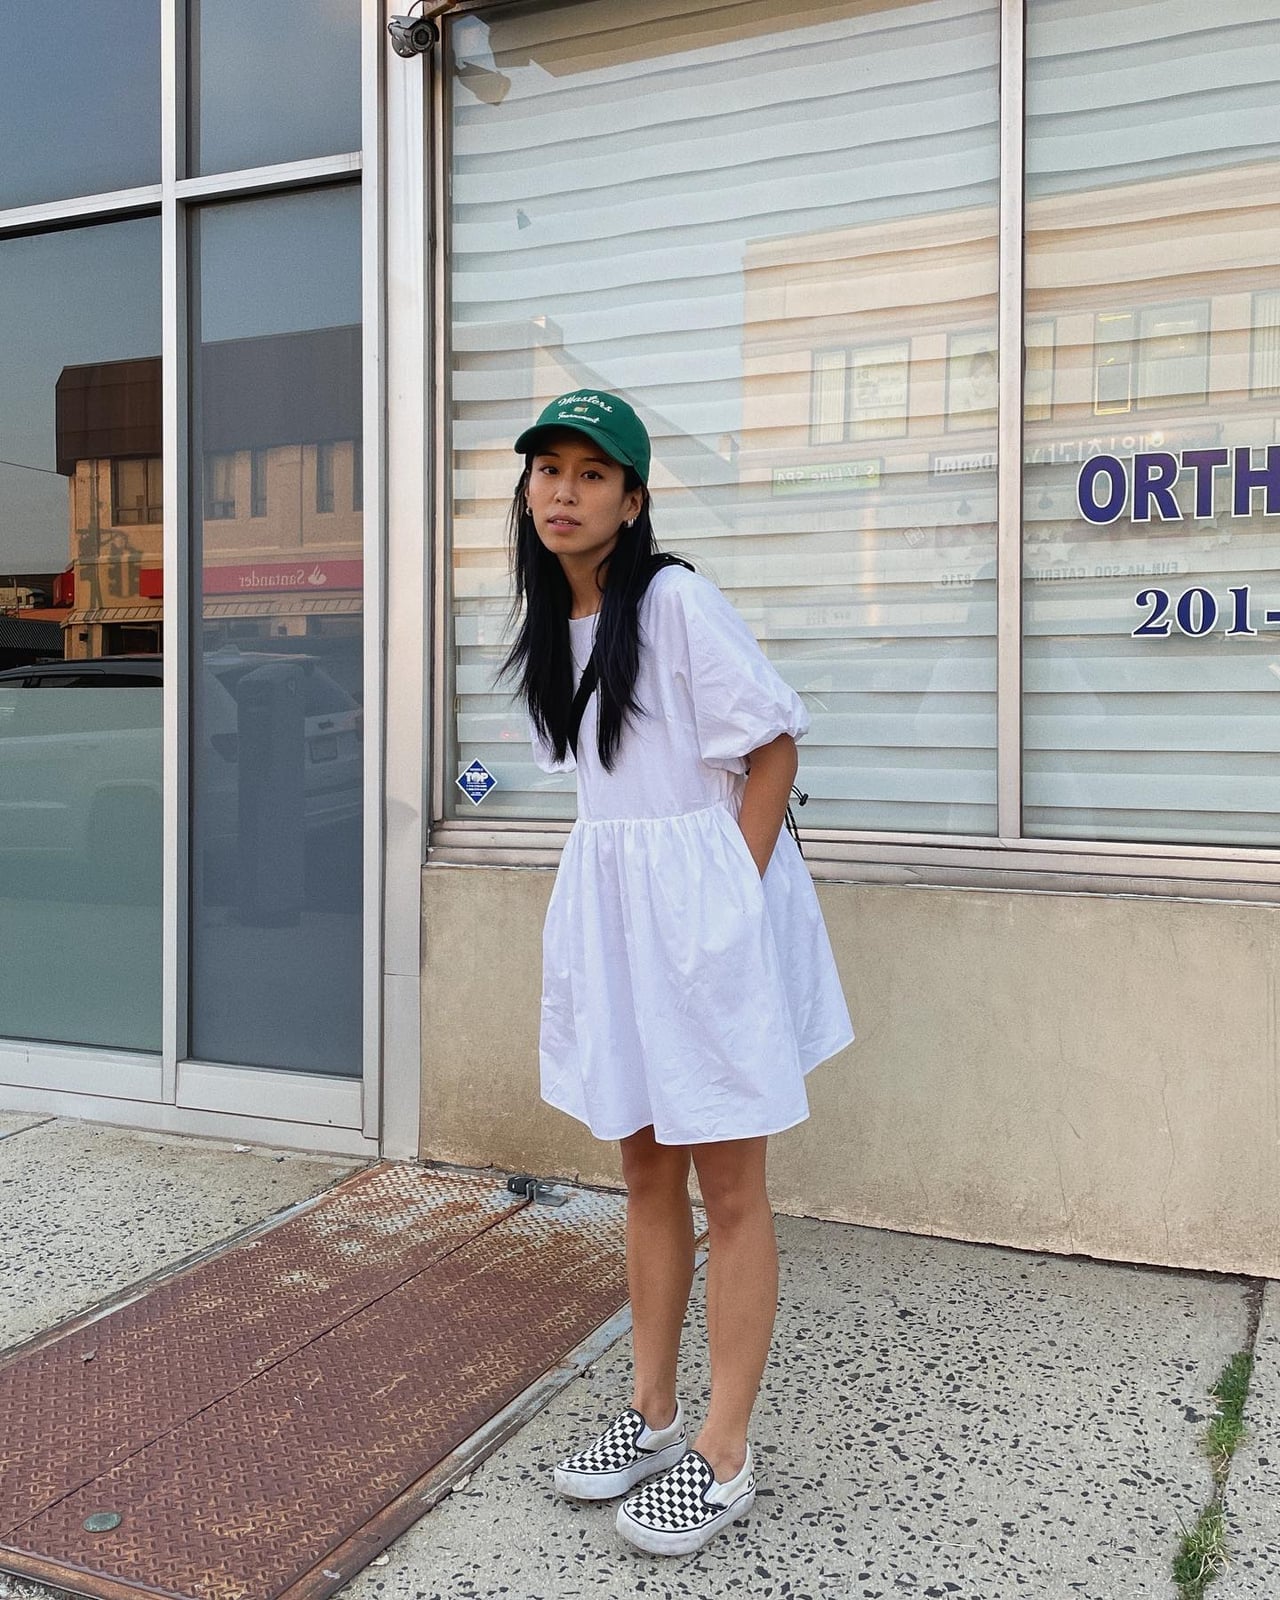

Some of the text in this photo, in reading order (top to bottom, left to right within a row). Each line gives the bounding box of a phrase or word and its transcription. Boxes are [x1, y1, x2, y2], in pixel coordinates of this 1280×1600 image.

[558, 394, 613, 413] Masters
[1077, 444, 1280, 525] ORTH
[1131, 584, 1280, 638] 201-
[465, 772, 489, 783] TOP
